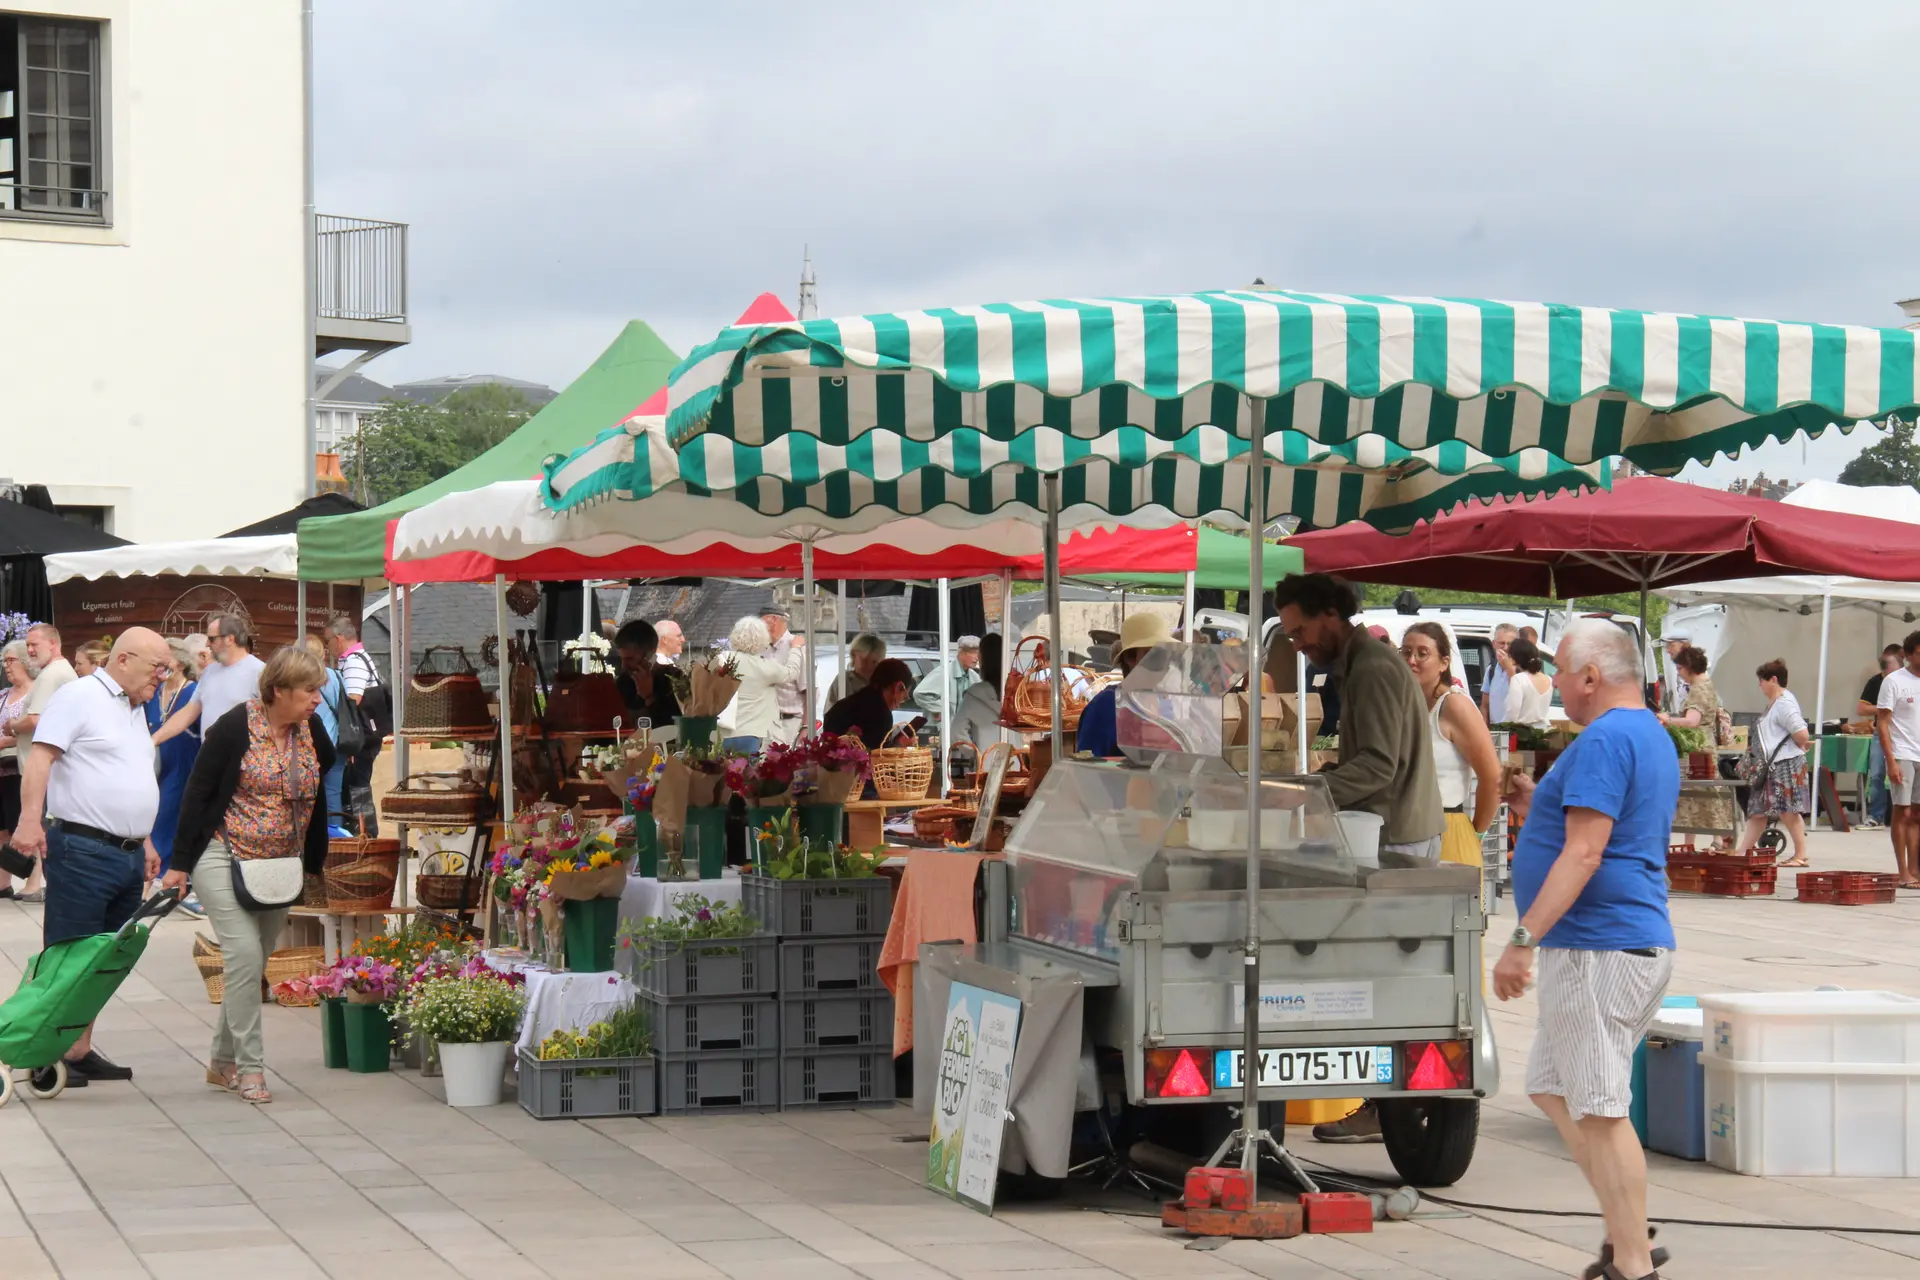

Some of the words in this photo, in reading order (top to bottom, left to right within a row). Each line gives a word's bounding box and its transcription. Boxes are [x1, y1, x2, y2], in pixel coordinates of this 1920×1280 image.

[82, 601, 109, 612] Légumes
[119, 600, 135, 608] fruits
[267, 601, 295, 612] Cultivés
[95, 614, 103, 623] de
[104, 614, 123, 623] saison
[941, 1052, 970, 1084] FERME
[1377, 1066, 1392, 1080] 53
[1220, 1072, 1227, 1081] F
